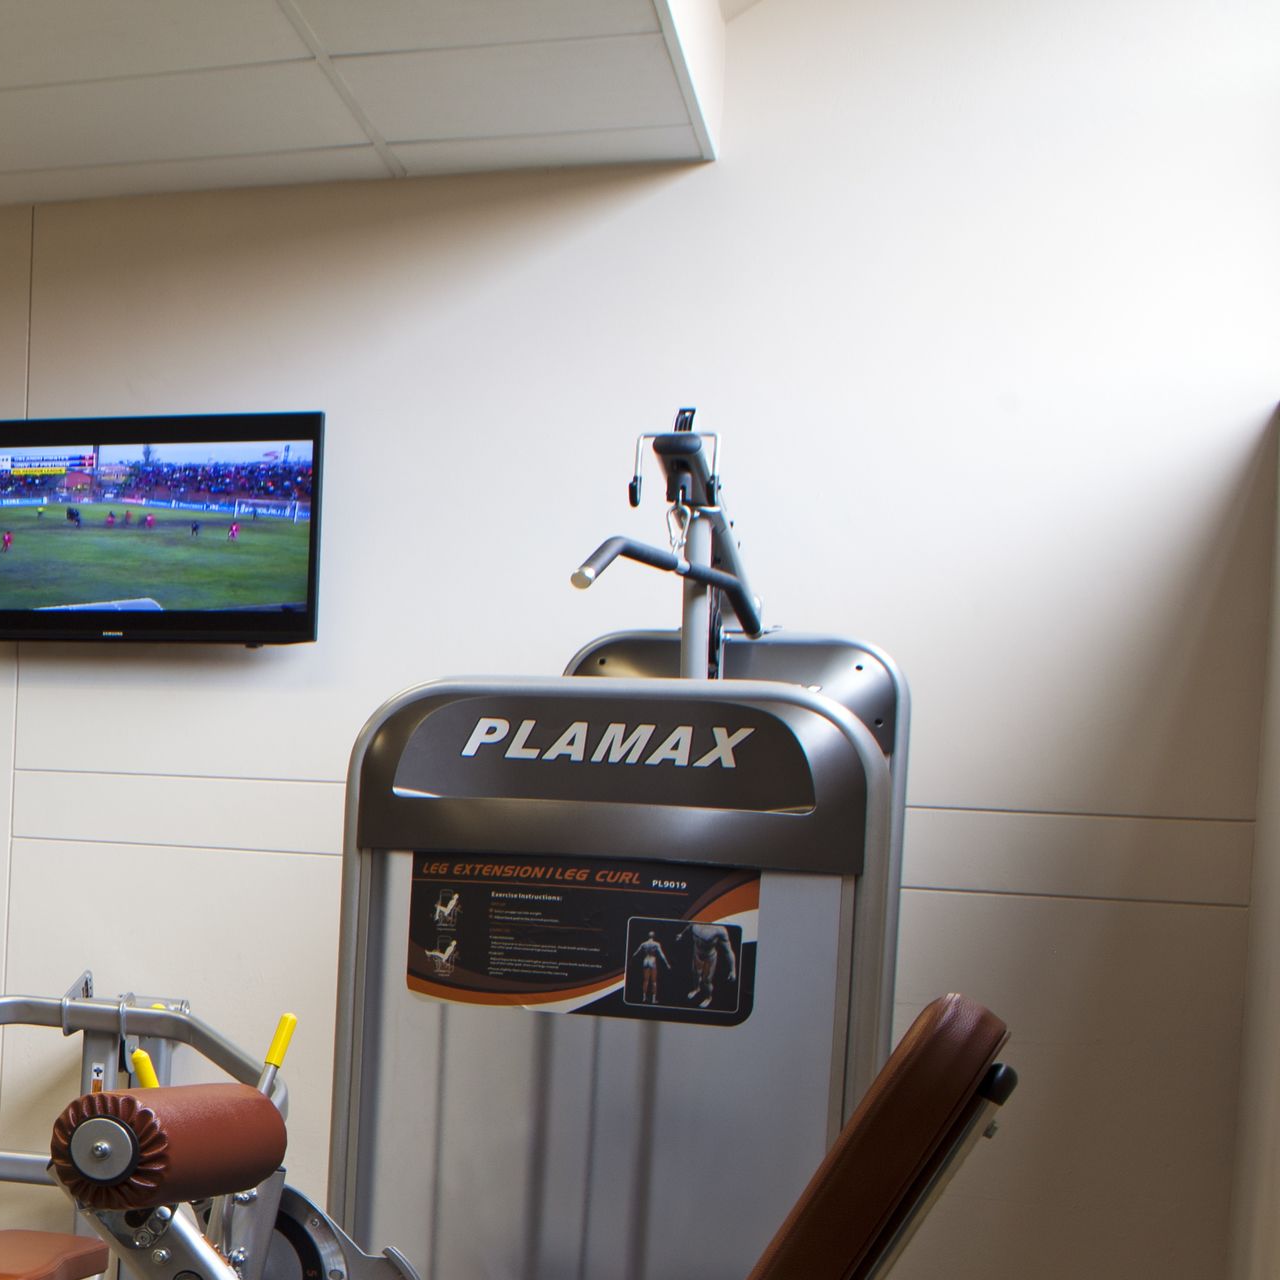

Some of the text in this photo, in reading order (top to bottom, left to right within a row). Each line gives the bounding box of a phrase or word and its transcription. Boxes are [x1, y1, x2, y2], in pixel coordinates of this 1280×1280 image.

[461, 716, 756, 769] PLAMAX
[422, 863, 449, 875] LEG
[453, 864, 544, 879] EXTENSION
[554, 868, 590, 882] LEG
[595, 870, 641, 885] CURL
[652, 879, 687, 890] PL9019
[491, 891, 518, 899] Exercise
